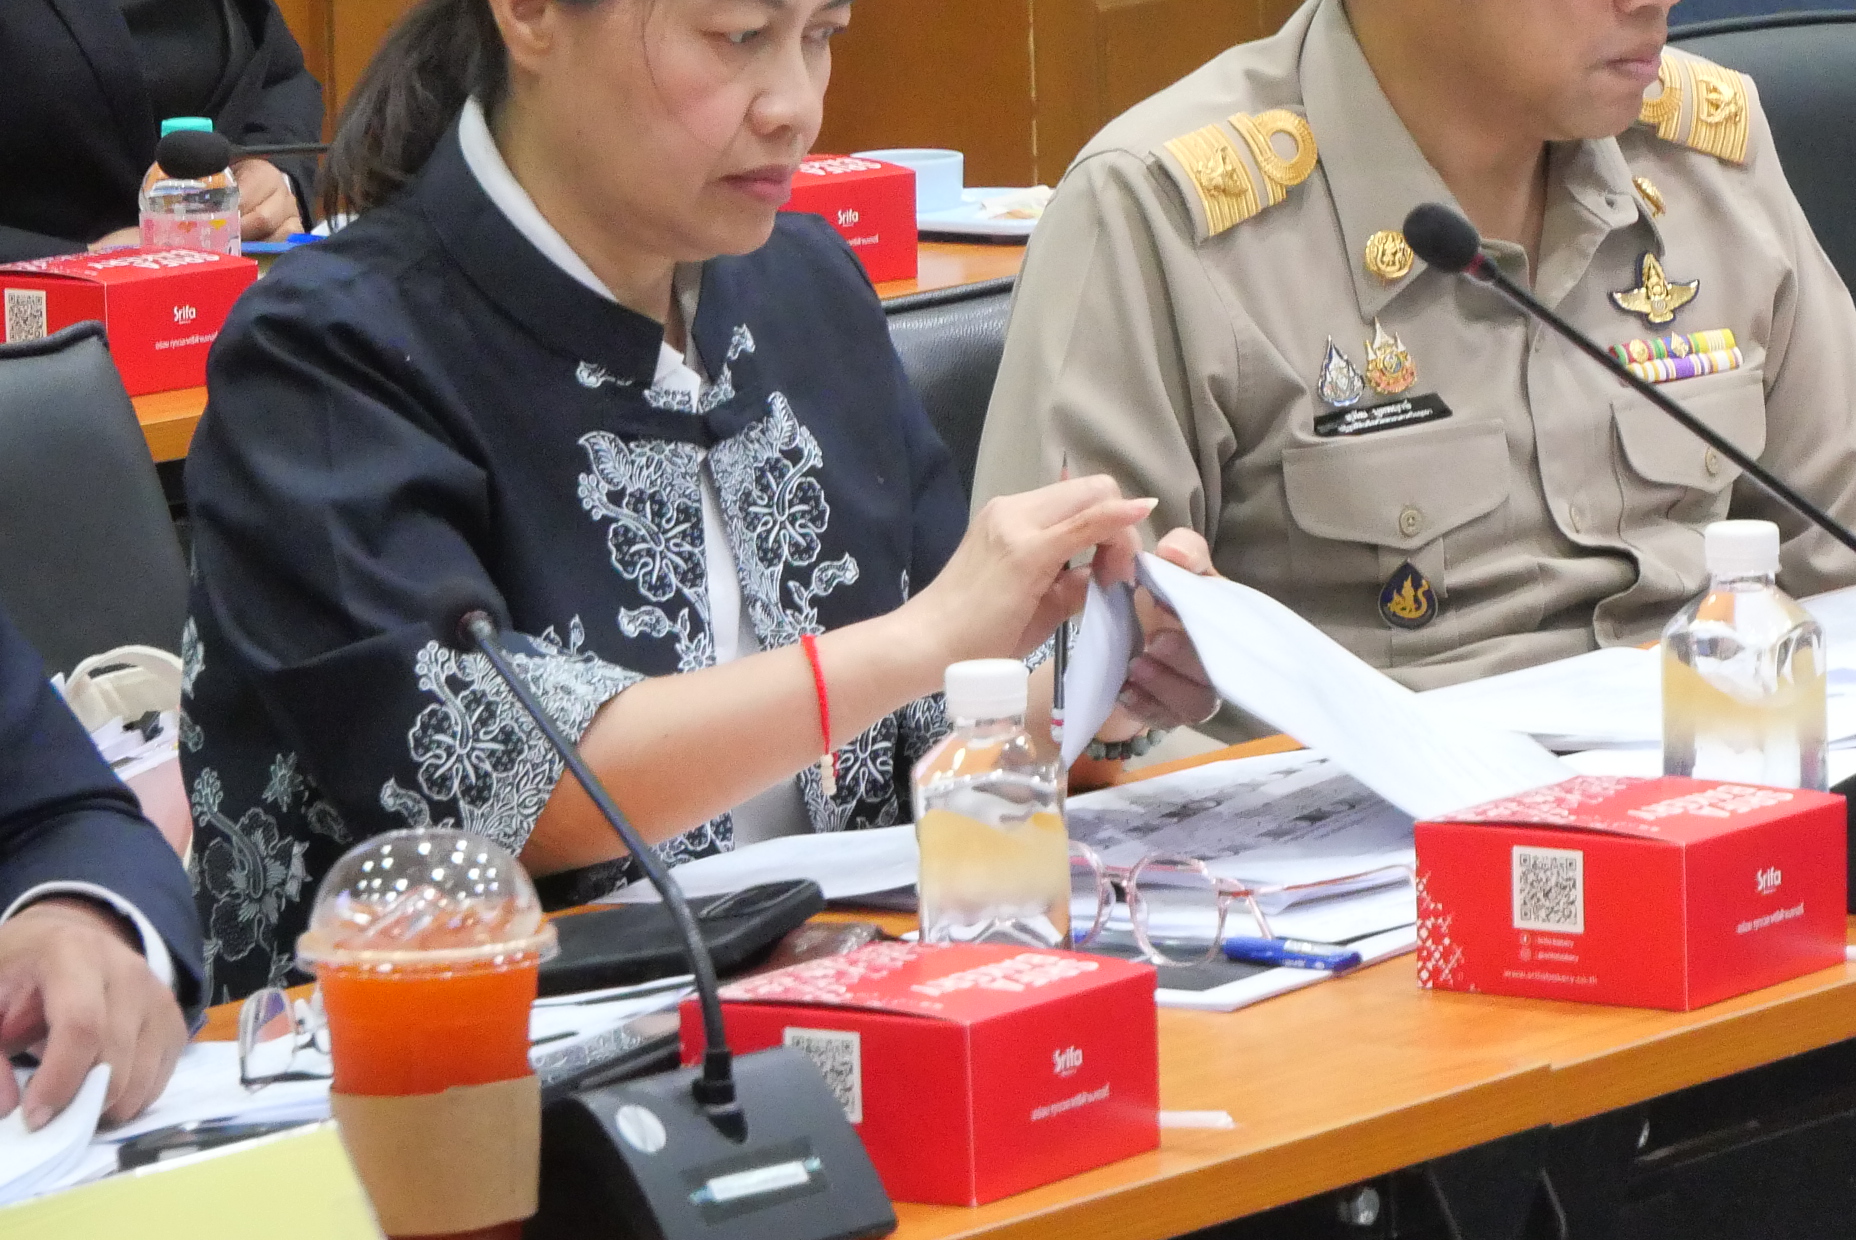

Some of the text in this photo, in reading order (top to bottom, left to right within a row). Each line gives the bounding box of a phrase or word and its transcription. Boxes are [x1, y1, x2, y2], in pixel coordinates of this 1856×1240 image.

[837, 209, 859, 225] Srifa
[173, 305, 196, 322] Srifa
[1756, 865, 1782, 892] Srifa
